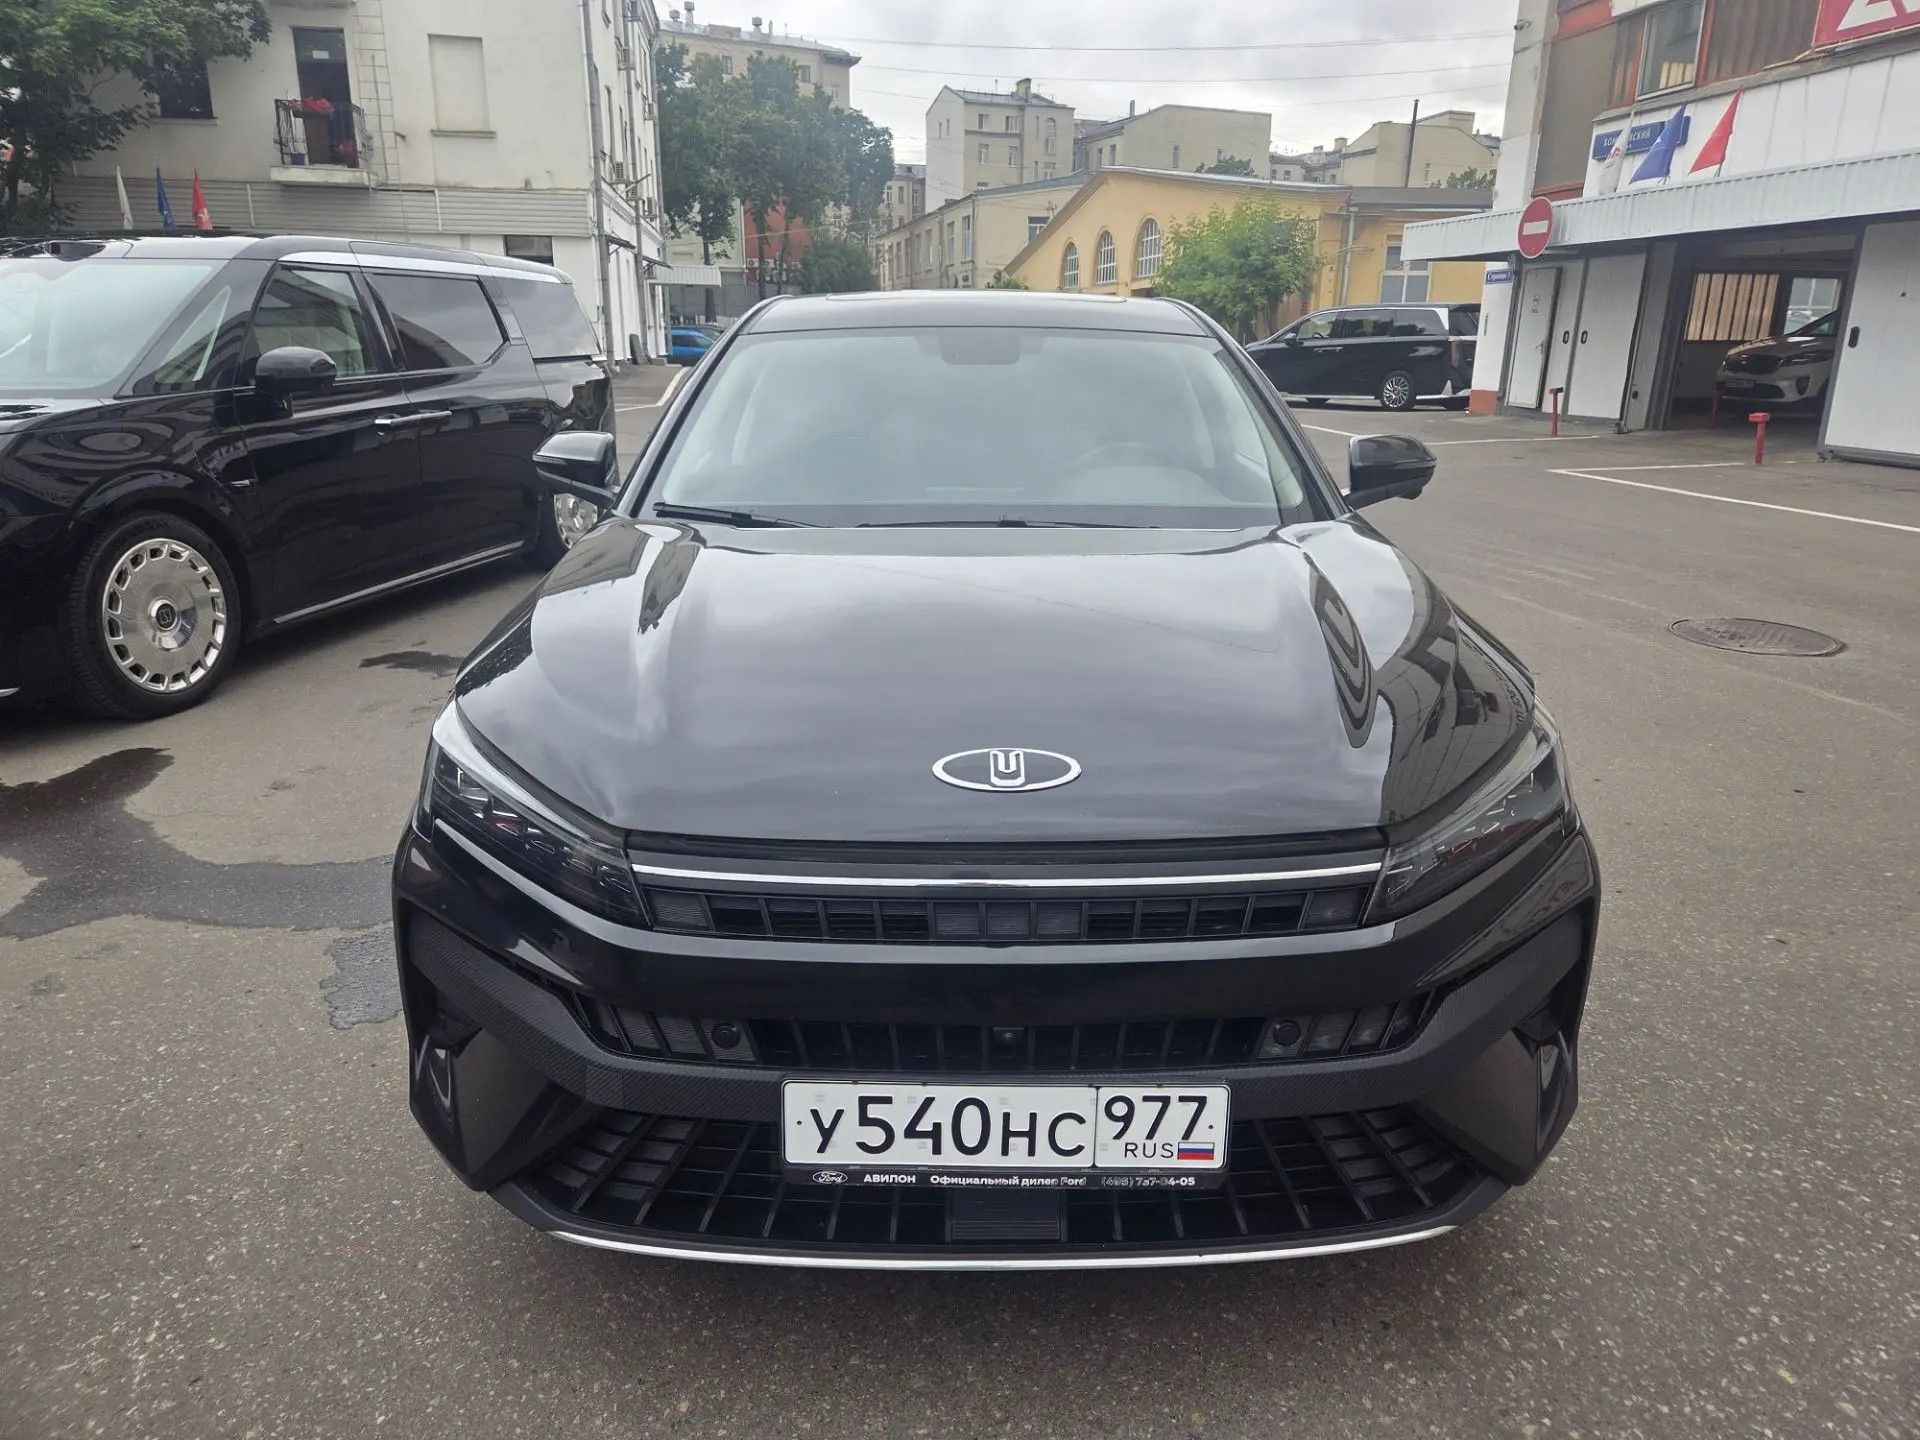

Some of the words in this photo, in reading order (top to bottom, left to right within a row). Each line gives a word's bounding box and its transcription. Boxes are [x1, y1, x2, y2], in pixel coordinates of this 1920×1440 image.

[810, 1096, 1087, 1157] У540НС
[1104, 1095, 1208, 1141] 977
[1124, 1142, 1174, 1158] RUS
[816, 1172, 845, 1184] Ford
[864, 1174, 916, 1184] АВИЛОН
[930, 1175, 1020, 1186] Официальный
[1021, 1177, 1059, 1187] дилер
[1060, 1176, 1087, 1186] Ford
